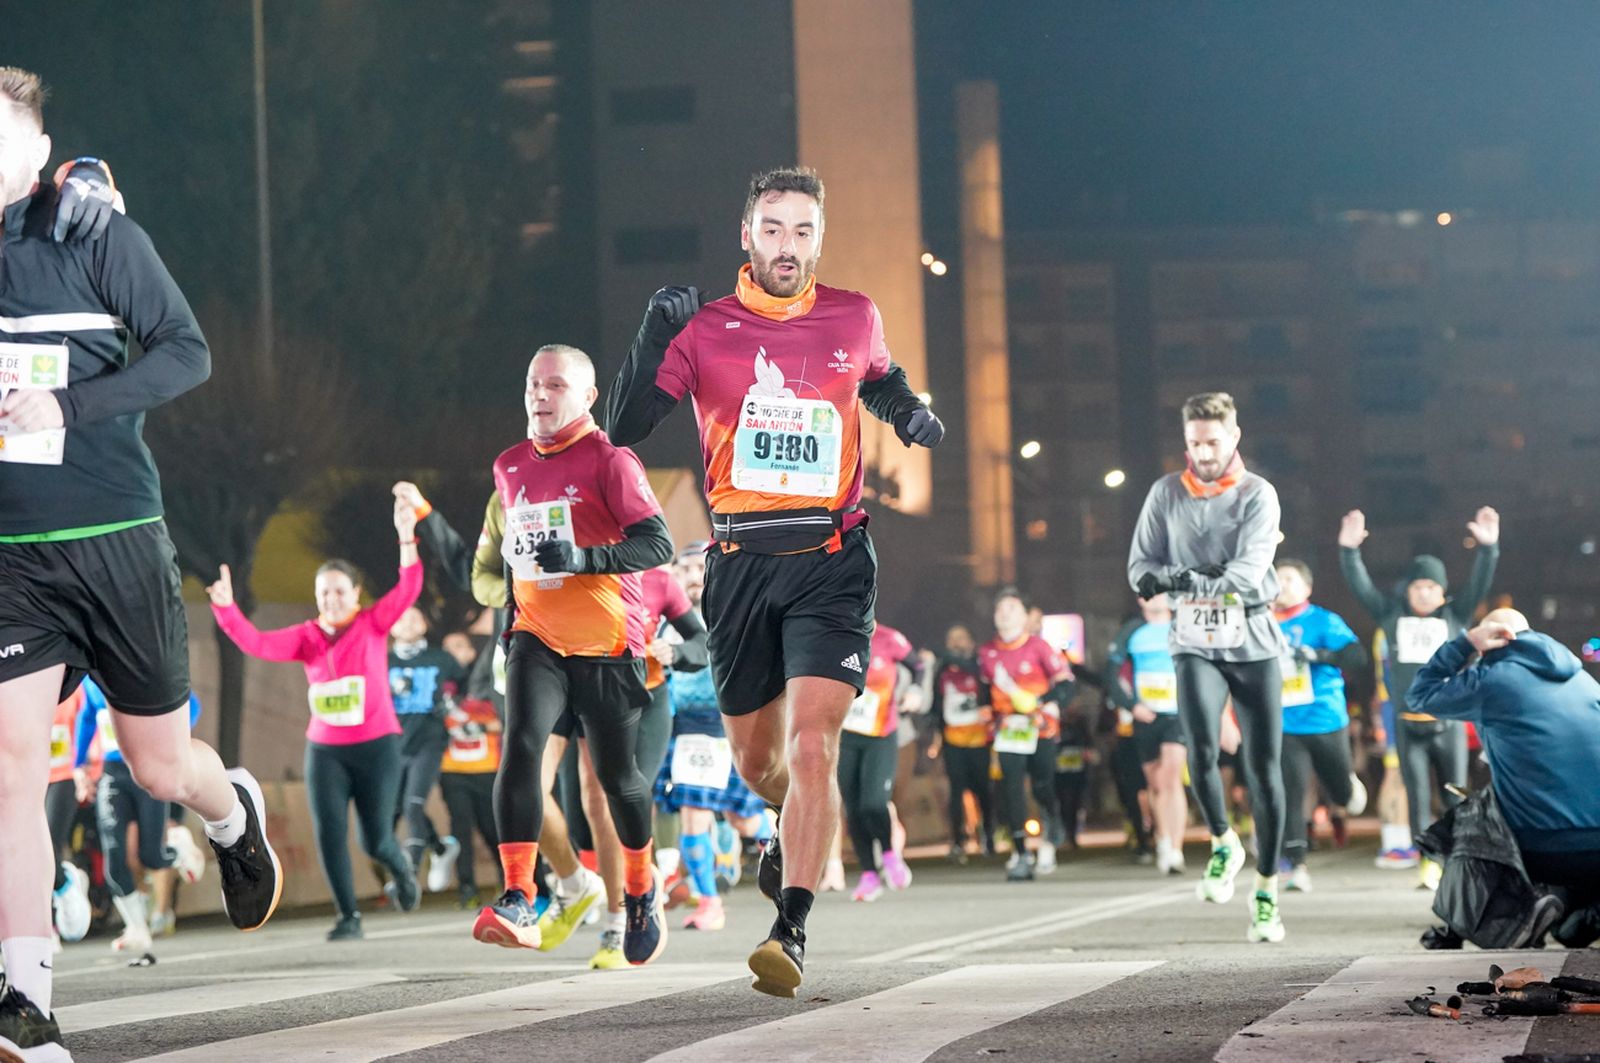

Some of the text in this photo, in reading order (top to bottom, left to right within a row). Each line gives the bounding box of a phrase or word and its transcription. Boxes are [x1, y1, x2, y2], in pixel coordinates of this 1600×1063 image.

[6, 358, 19, 368] DE
[792, 410, 805, 420] DE
[745, 418, 766, 429] SAN
[754, 432, 819, 464] 9180
[1193, 608, 1228, 625] 2141
[841, 661, 863, 673] adidas
